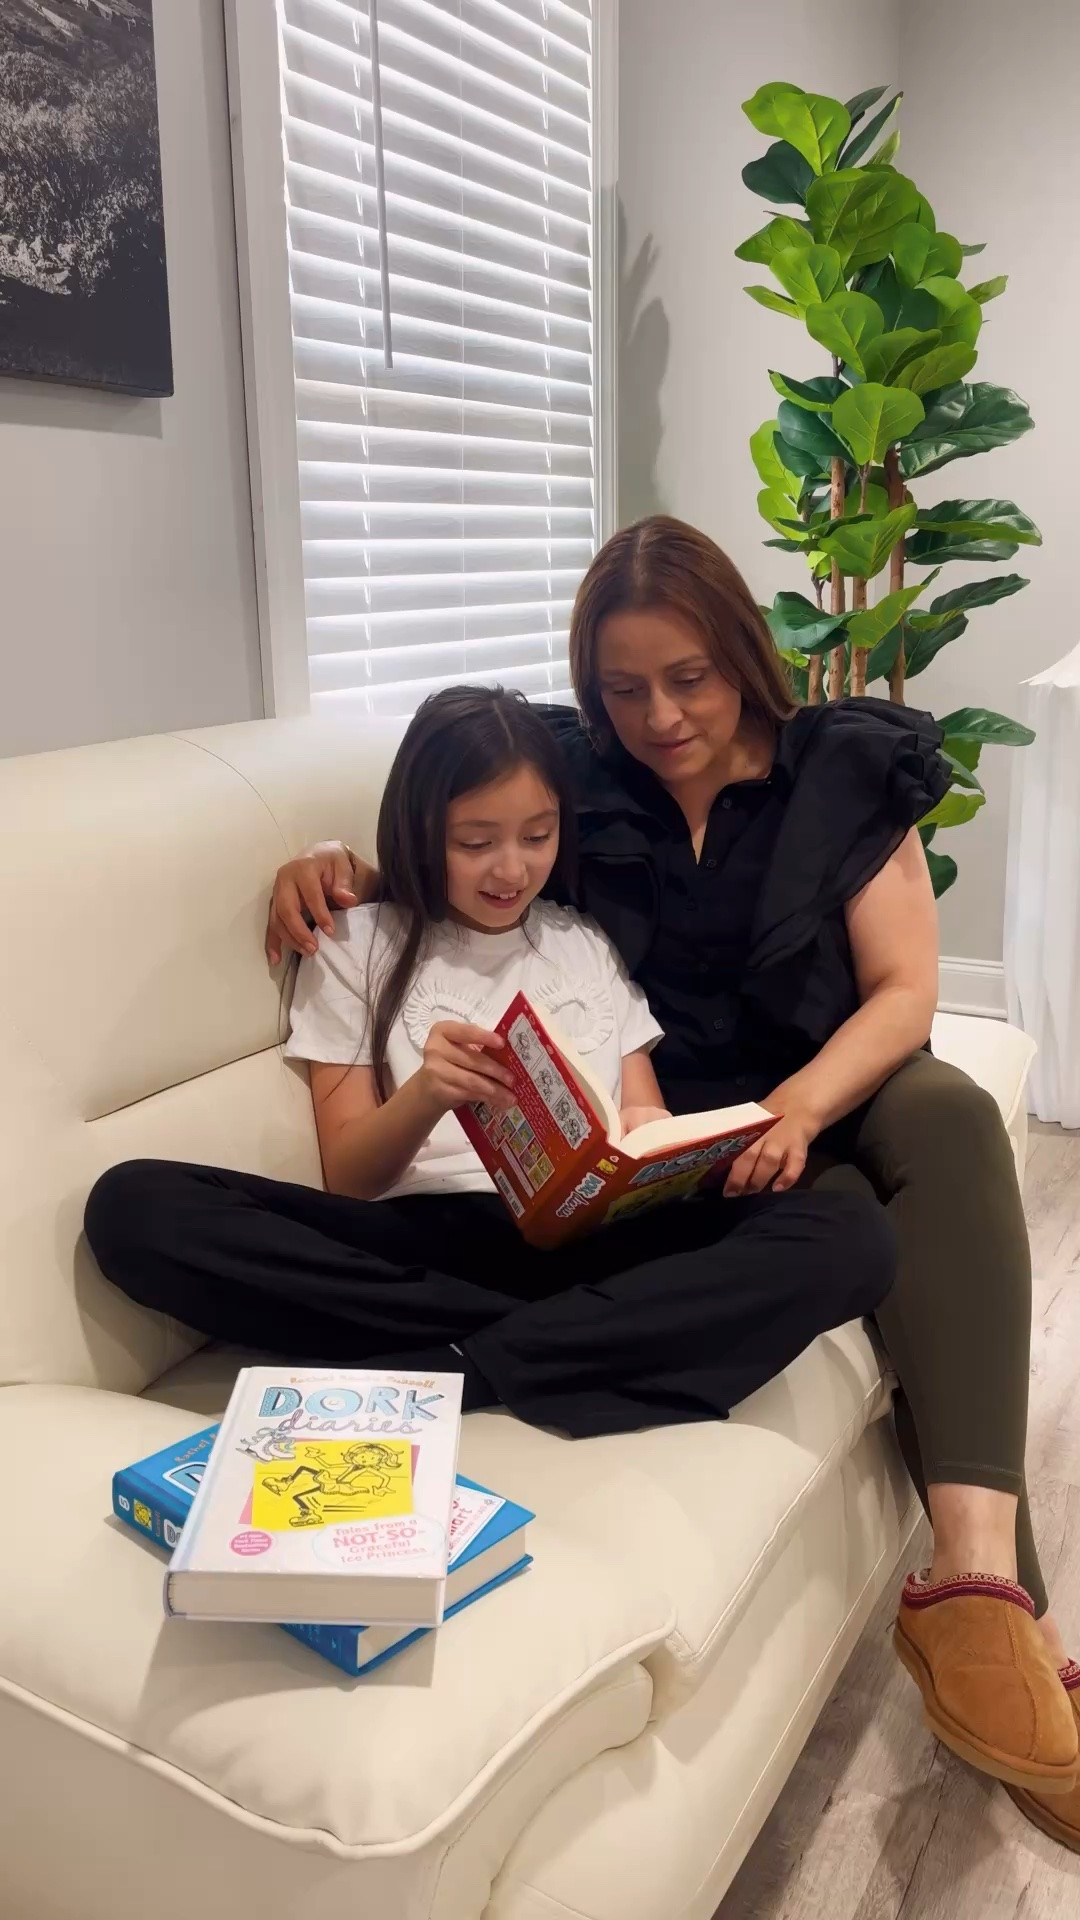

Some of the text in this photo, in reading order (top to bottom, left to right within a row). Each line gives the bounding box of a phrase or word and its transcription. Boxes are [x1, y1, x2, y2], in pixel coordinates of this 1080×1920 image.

[258, 1386, 445, 1421] DORK
[278, 1409, 422, 1434] diaries
[335, 1525, 369, 1536] Tales
[374, 1520, 405, 1531] from
[333, 1527, 426, 1549] NOT-SO-
[349, 1540, 411, 1554] Graceful
[367, 1547, 427, 1560] Princess
